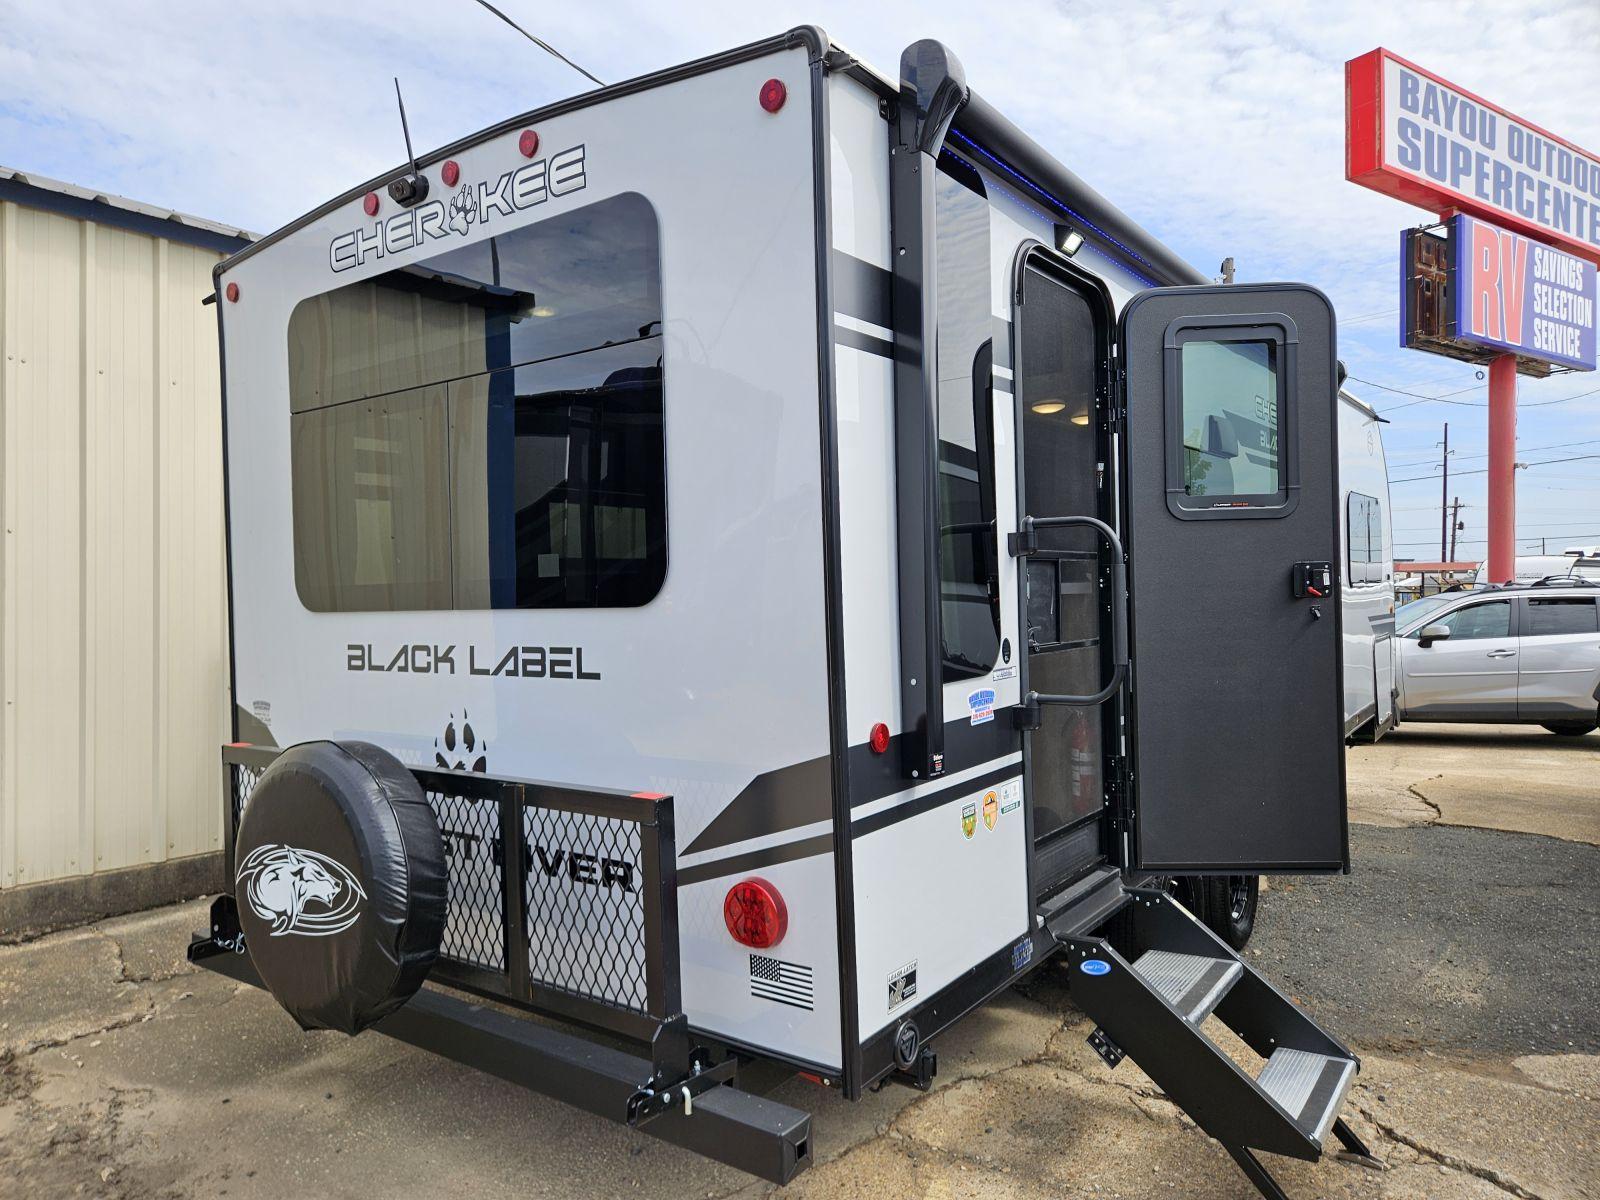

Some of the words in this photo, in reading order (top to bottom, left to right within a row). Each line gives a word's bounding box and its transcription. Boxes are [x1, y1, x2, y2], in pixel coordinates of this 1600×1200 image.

[1399, 69, 1497, 150] BAYOU
[1471, 220, 1528, 346] RV
[1534, 247, 1583, 292] SAVINGS
[1533, 283, 1592, 329] SELECTION
[1533, 317, 1581, 359] SERVICE
[347, 644, 456, 674] BLACK
[469, 645, 601, 680] LABEL
